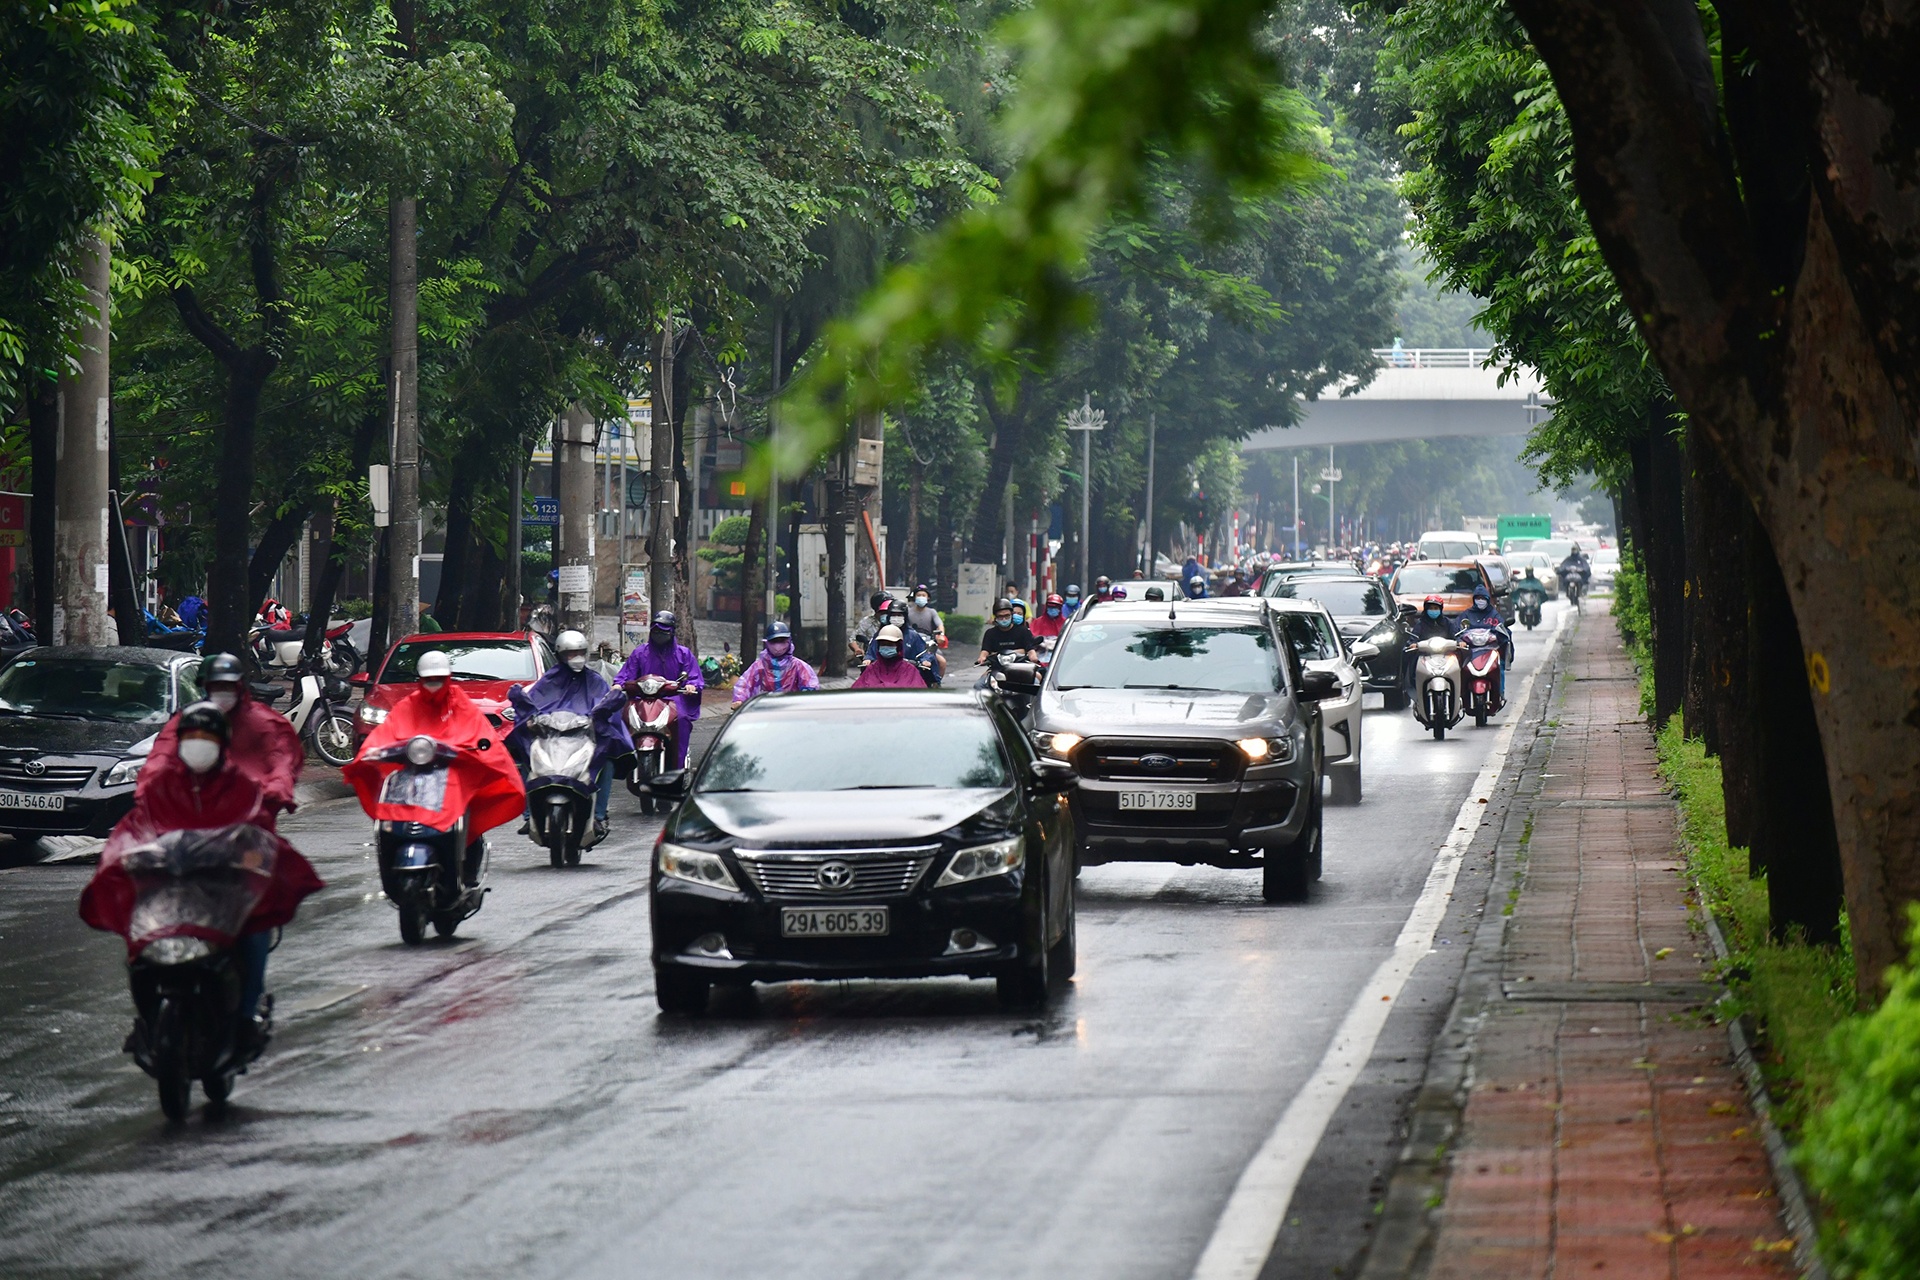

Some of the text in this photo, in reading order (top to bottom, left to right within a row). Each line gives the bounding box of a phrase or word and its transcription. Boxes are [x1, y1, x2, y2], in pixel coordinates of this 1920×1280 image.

[541, 504, 557, 513] 123
[0, 793, 62, 810] 30A-546.40
[1121, 793, 1193, 808] 51D-173.99
[786, 912, 884, 932] 29A-605.39
